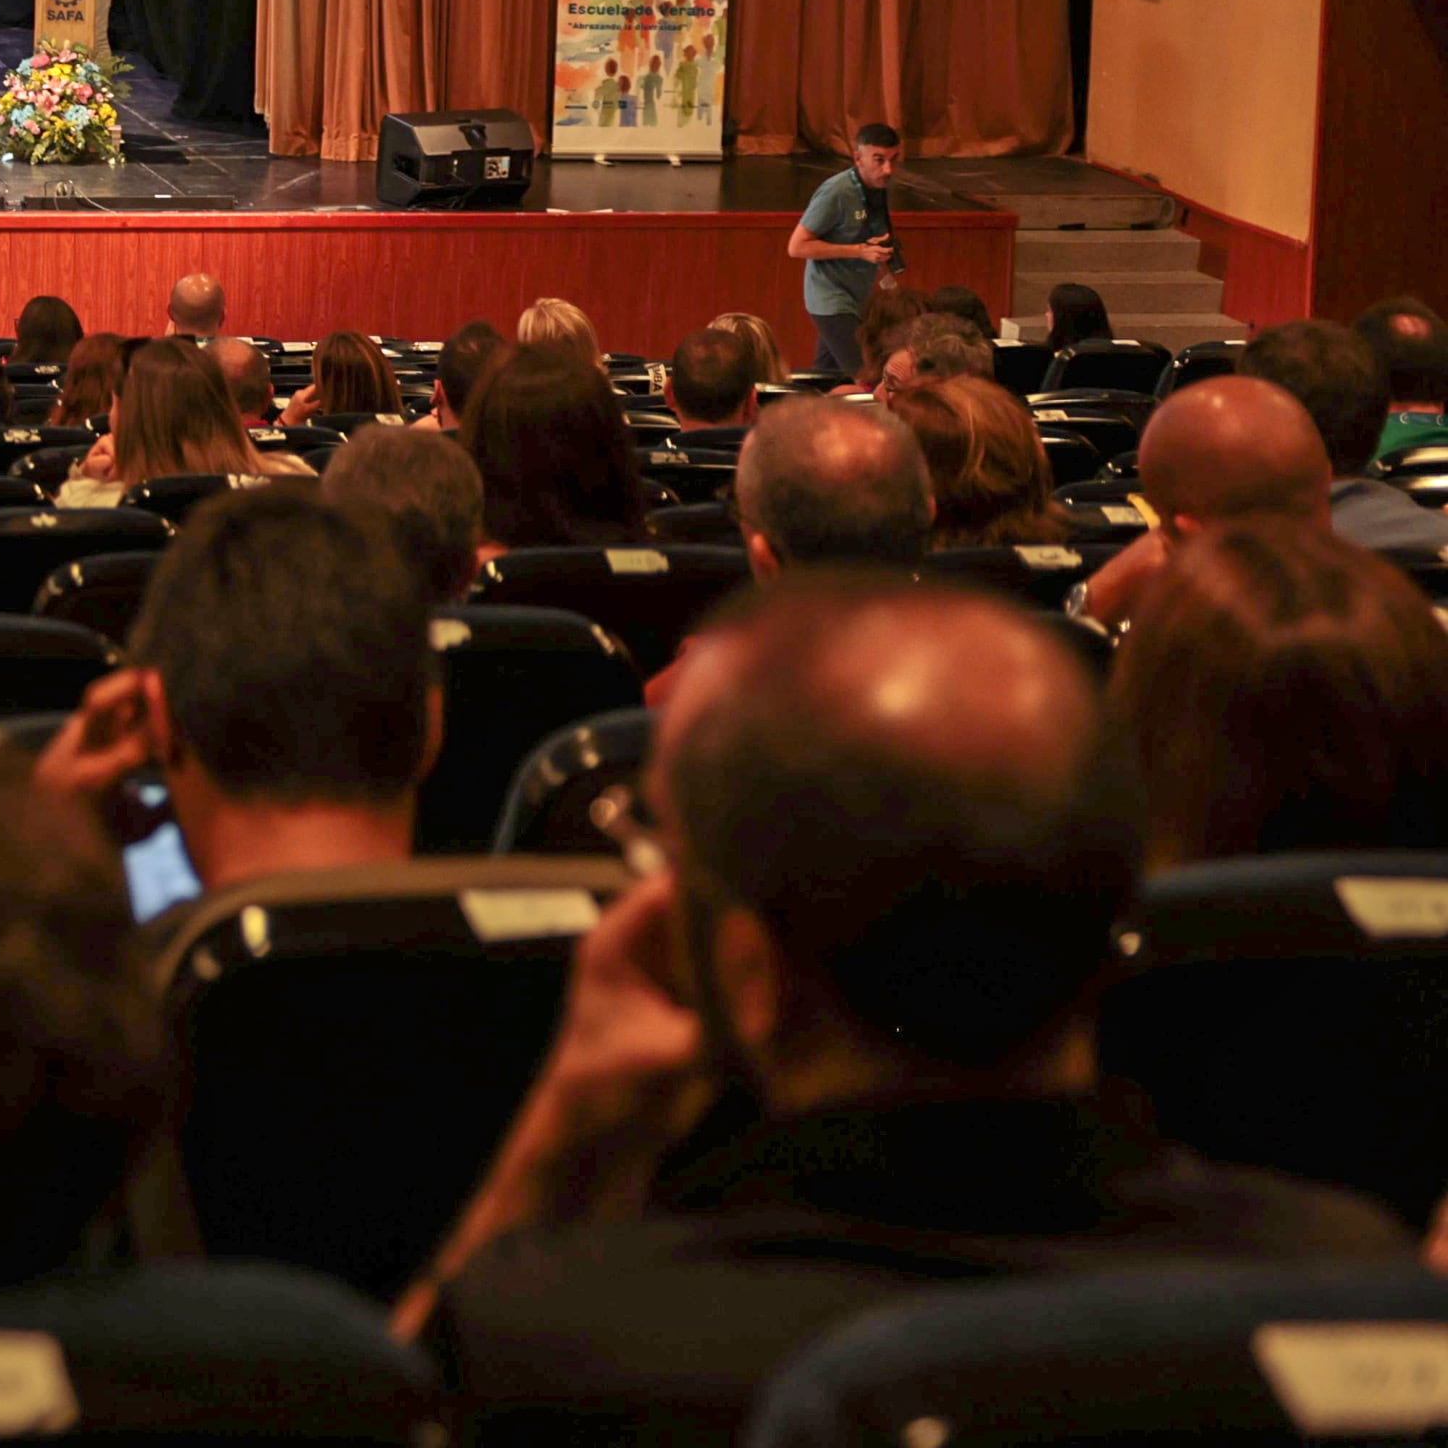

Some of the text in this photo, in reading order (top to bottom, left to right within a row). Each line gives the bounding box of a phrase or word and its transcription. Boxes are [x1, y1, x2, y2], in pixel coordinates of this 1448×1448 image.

[47, 9, 85, 22] SAFA
[567, 3, 716, 17] Escuela de Verano
